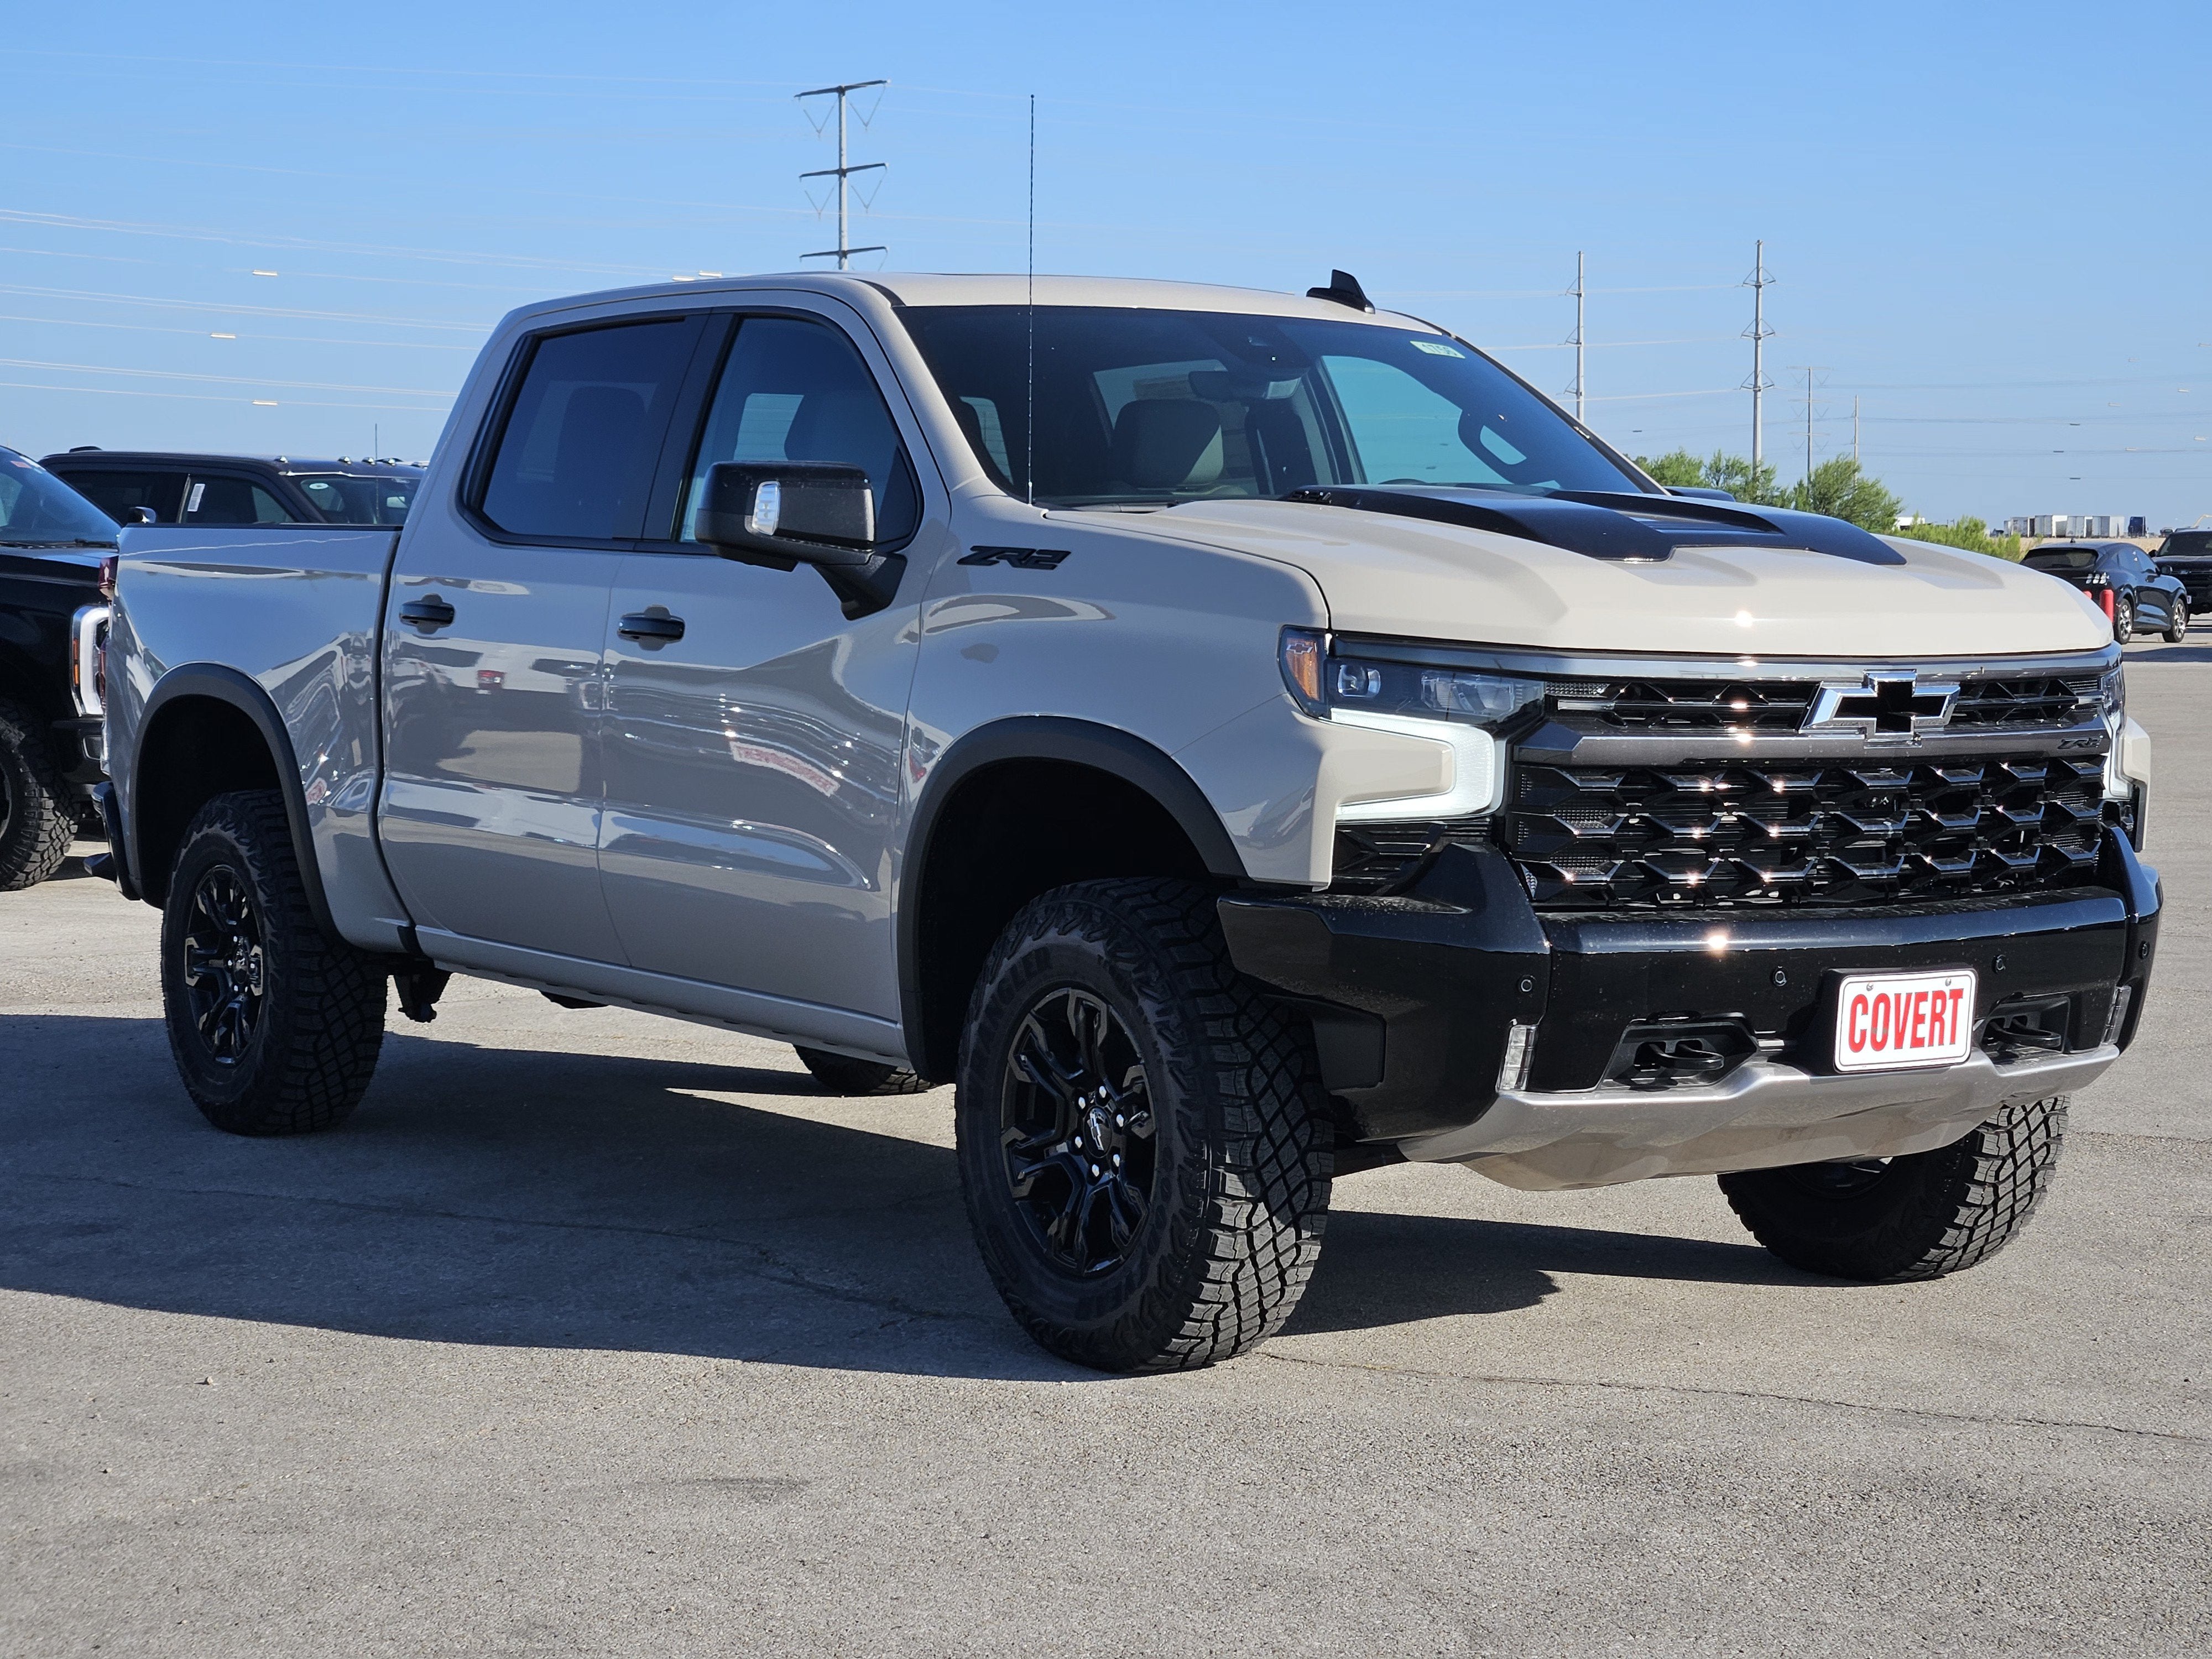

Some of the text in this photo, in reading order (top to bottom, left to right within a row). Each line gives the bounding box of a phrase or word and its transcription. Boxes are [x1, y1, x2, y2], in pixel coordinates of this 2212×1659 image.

[956, 545, 1072, 571] ZR2
[2057, 735, 2104, 750] ZR2
[1848, 988, 1964, 1053] COVERT
